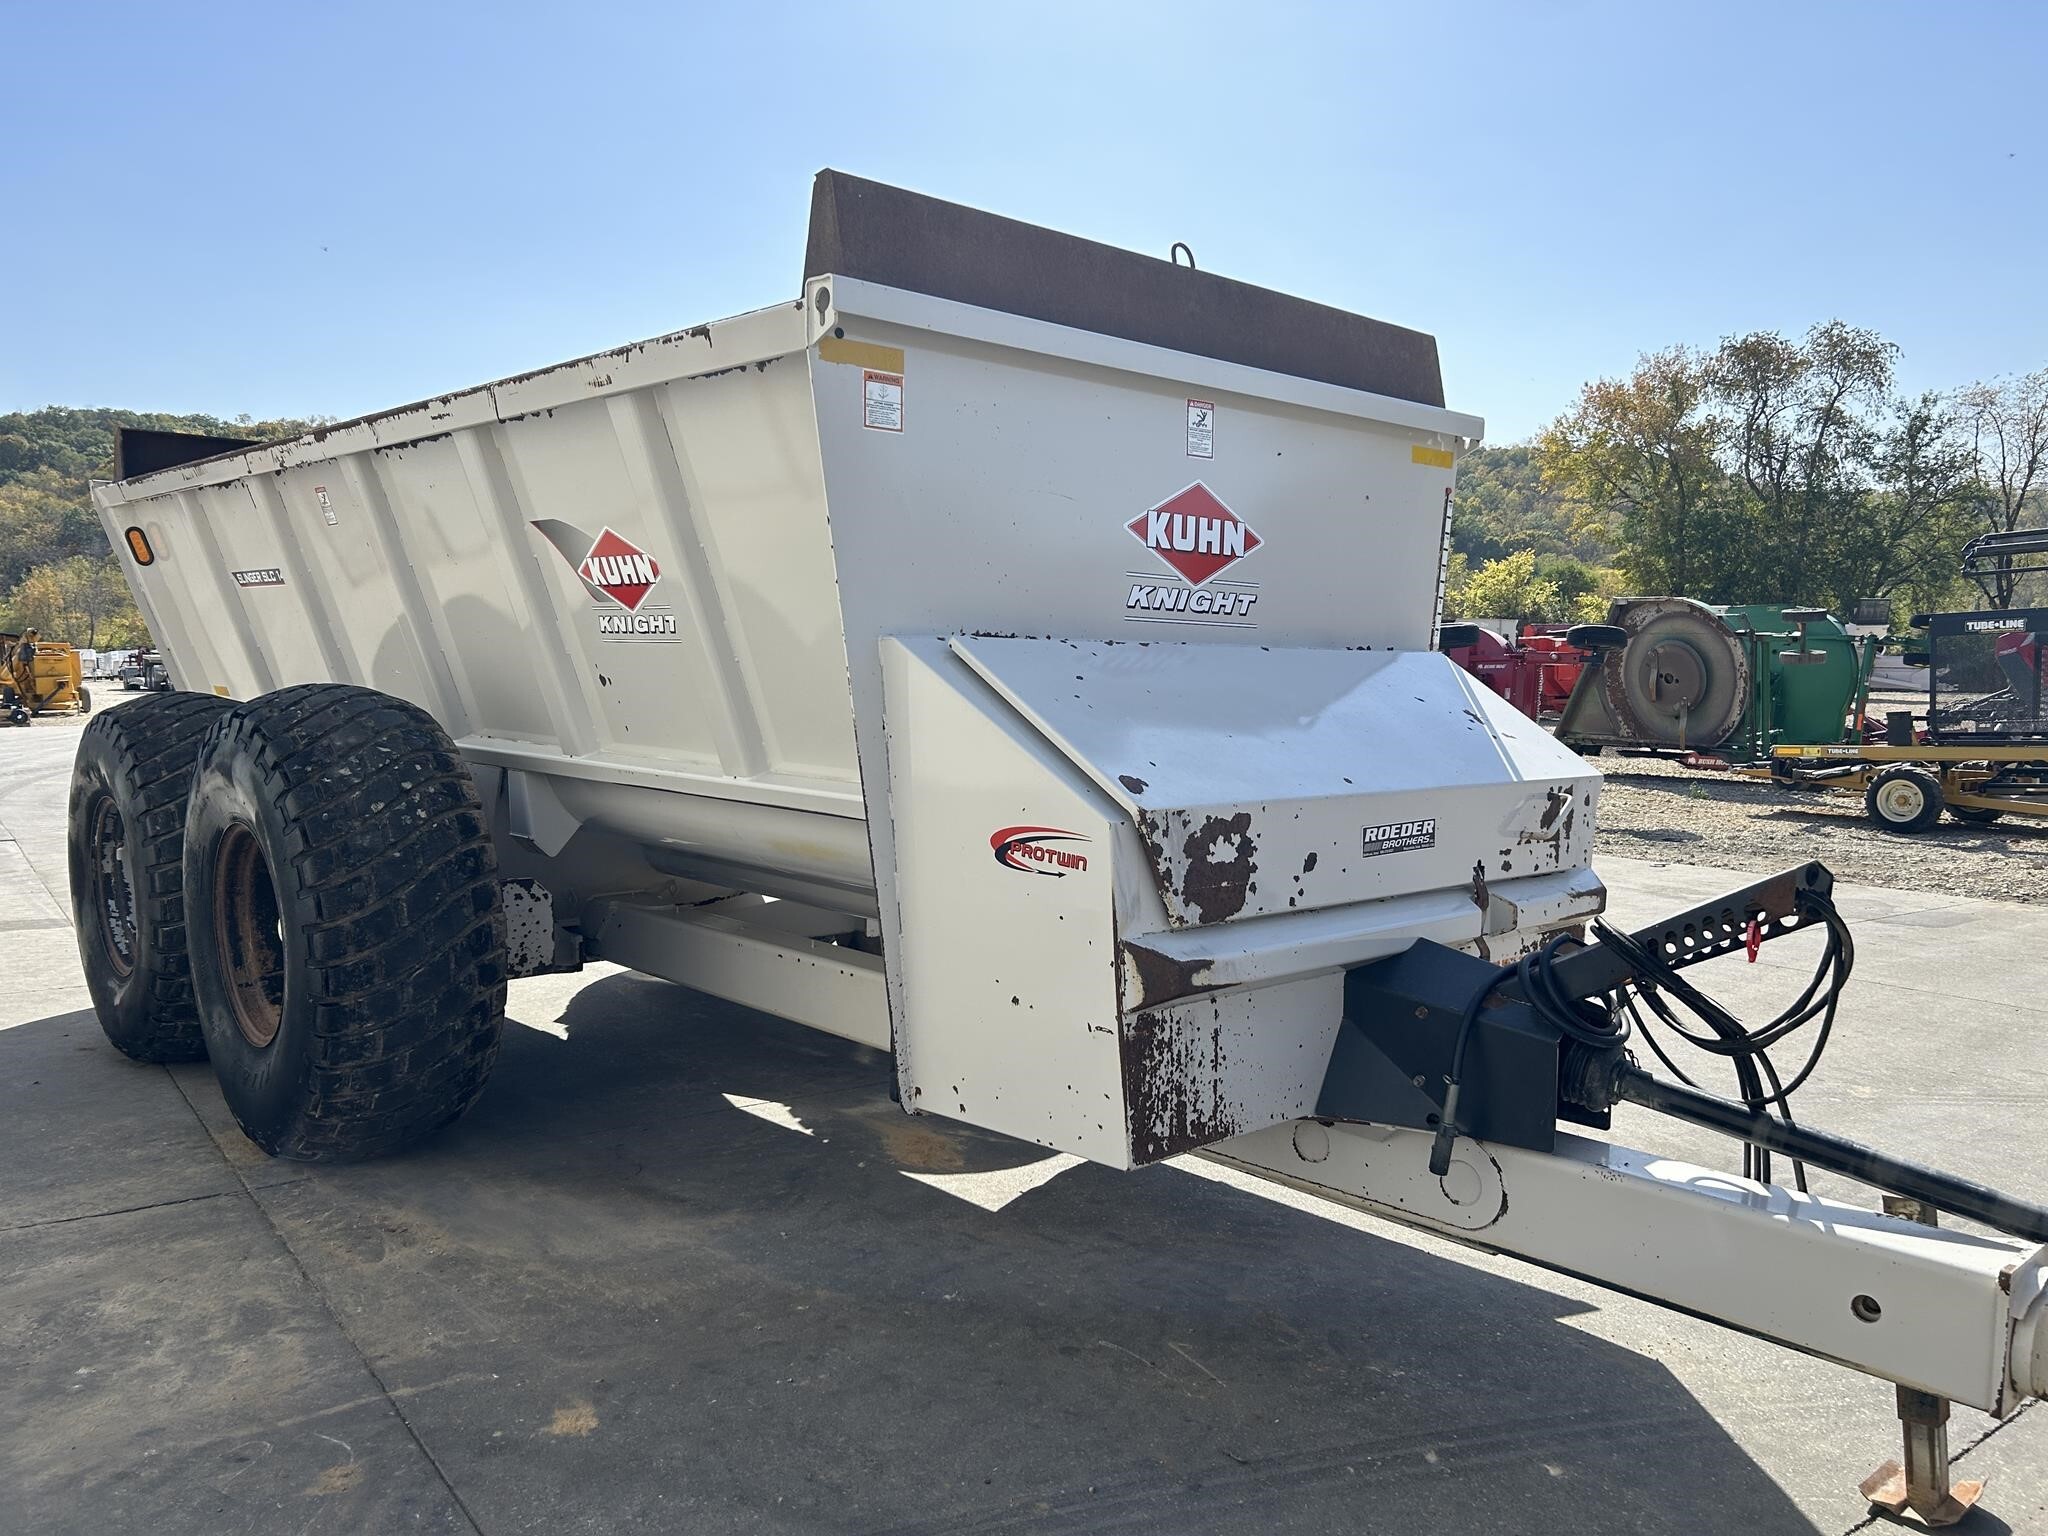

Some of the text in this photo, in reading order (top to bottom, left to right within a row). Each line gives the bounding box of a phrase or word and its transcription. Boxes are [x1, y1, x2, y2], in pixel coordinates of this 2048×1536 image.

[1146, 510, 1245, 558] KUHN
[586, 553, 656, 586] KUHN
[1126, 585, 1257, 616] KNIGHT
[599, 614, 677, 634] KNIGHT
[1365, 820, 1435, 842] ROEDER
[1382, 835, 1430, 849] BROTHERS
[1010, 841, 1088, 872] PROTWIN
